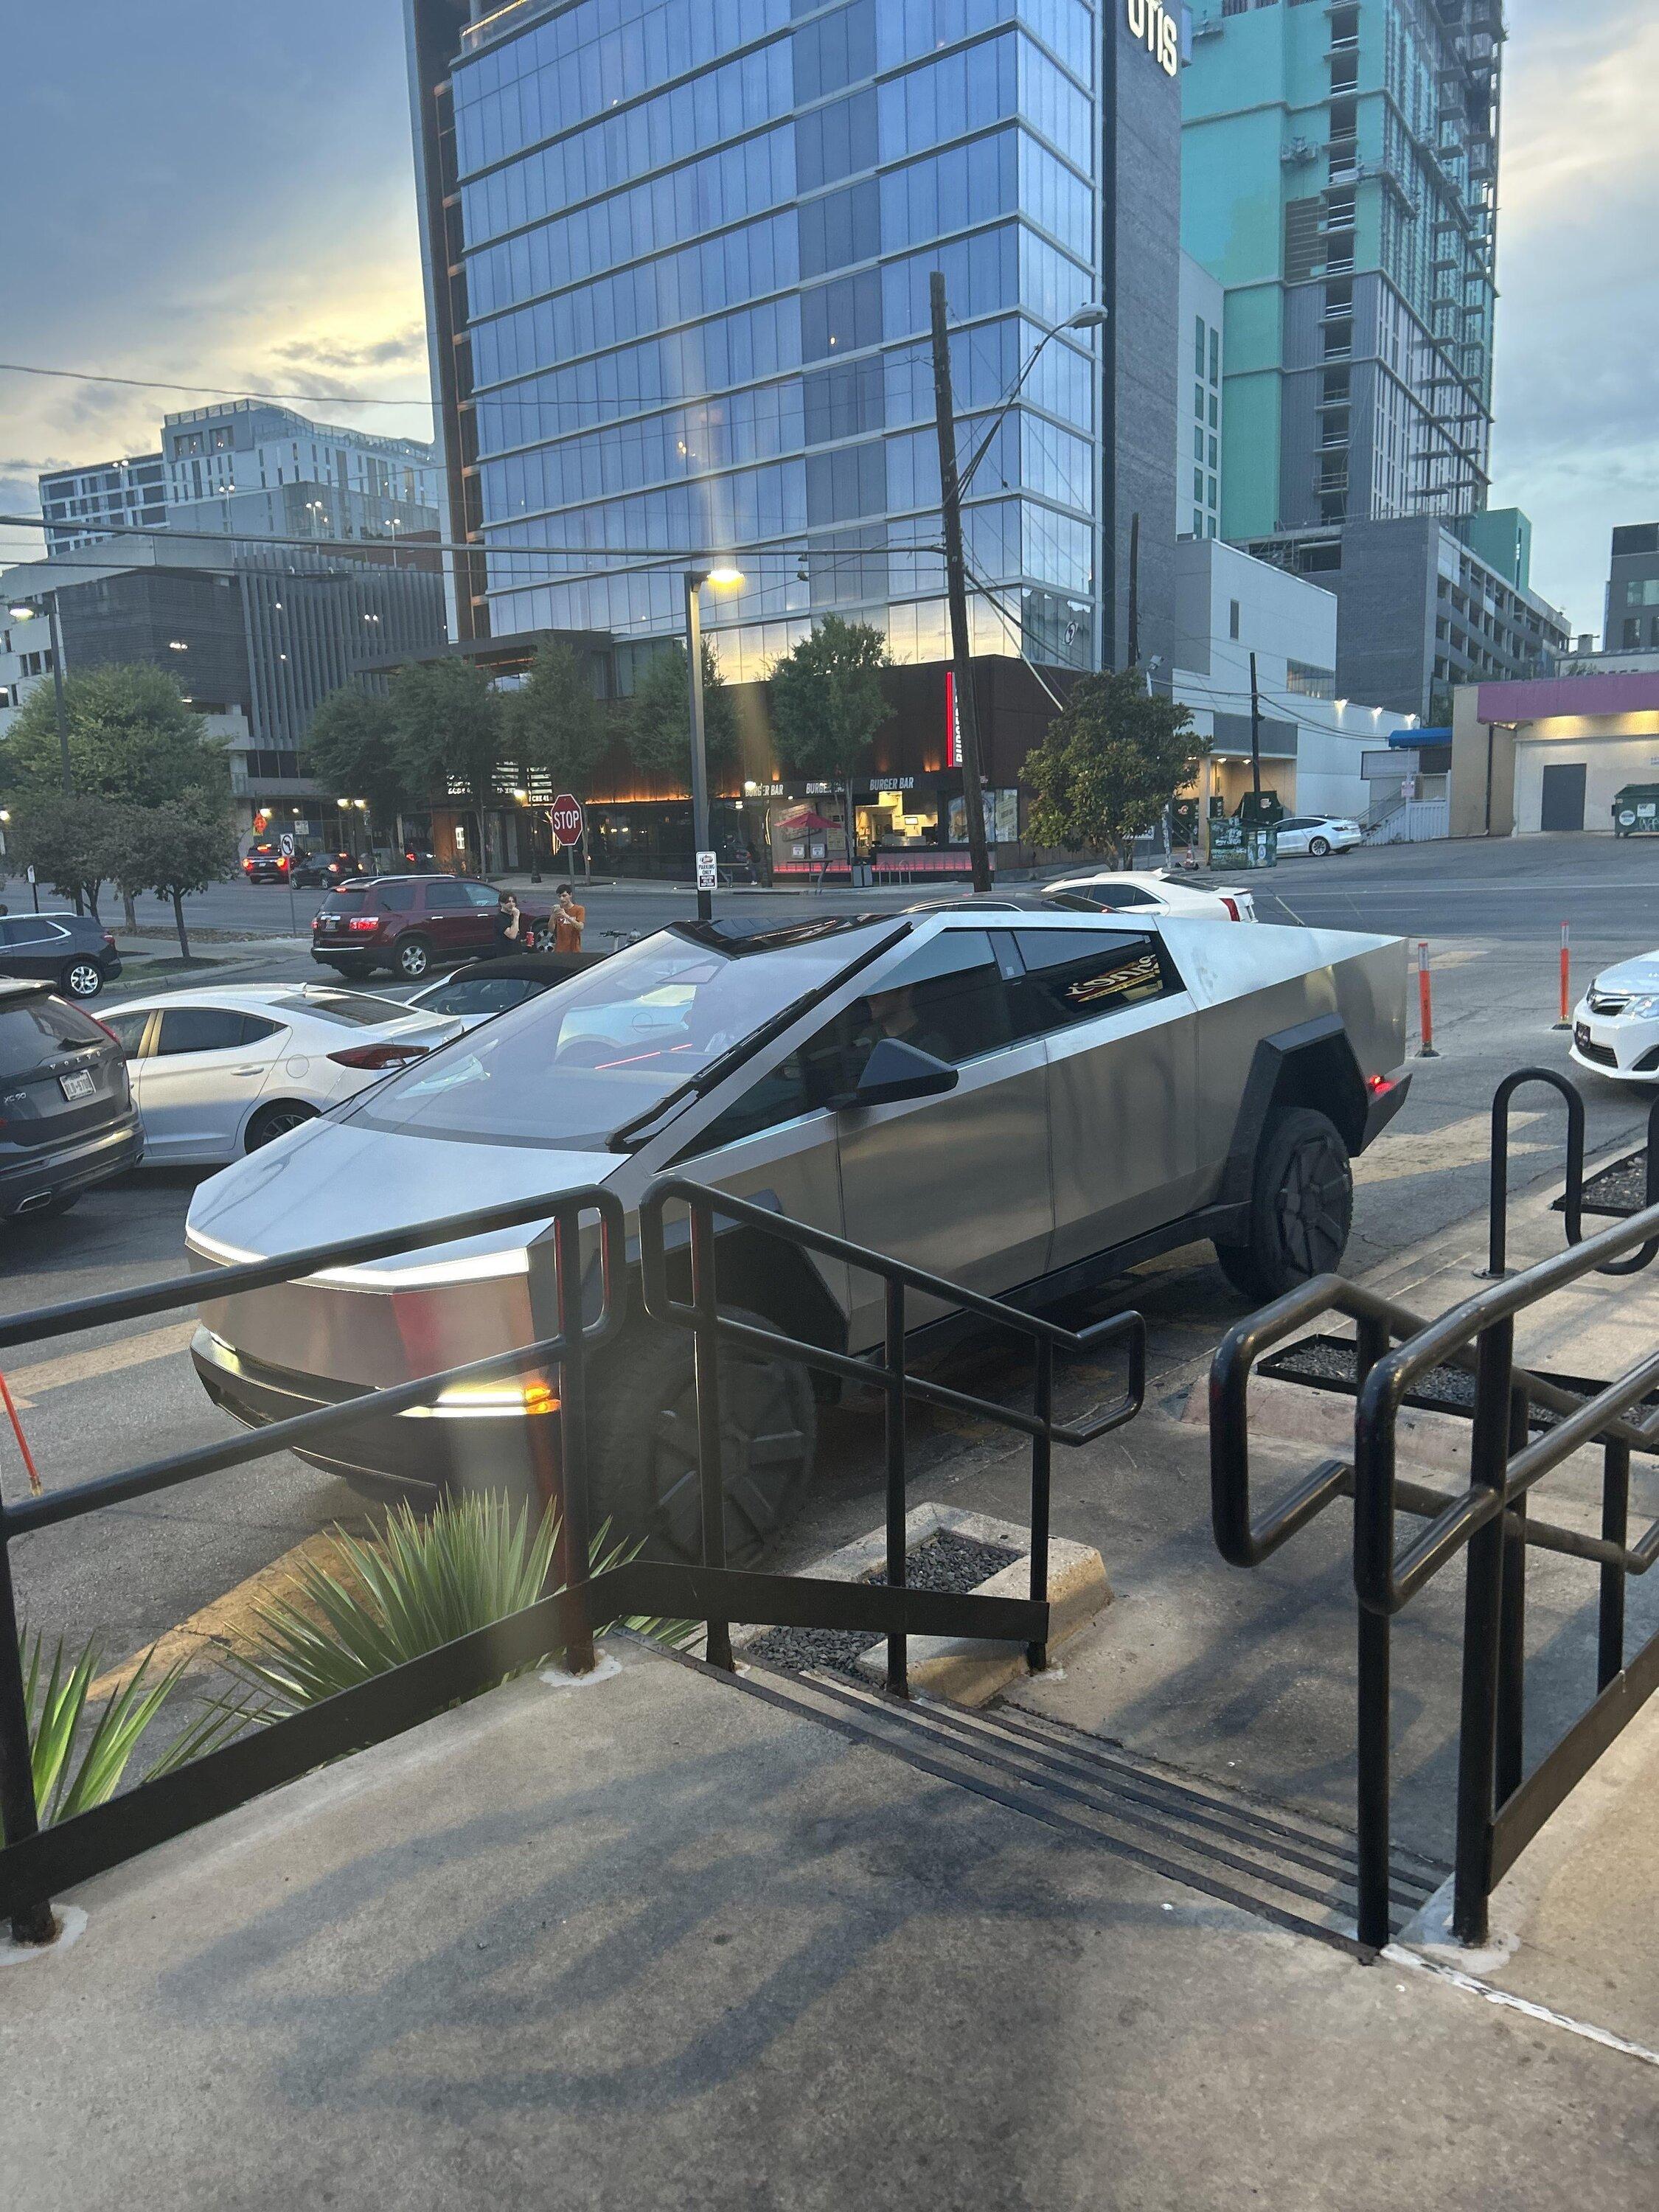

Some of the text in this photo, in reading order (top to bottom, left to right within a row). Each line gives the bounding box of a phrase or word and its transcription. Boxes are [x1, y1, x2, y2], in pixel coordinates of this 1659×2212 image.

[771, 784, 784, 796] BAR
[869, 776, 914, 790] BURGER BAR
[554, 810, 580, 830] STOP
[49, 1050, 101, 1070] VOLVO
